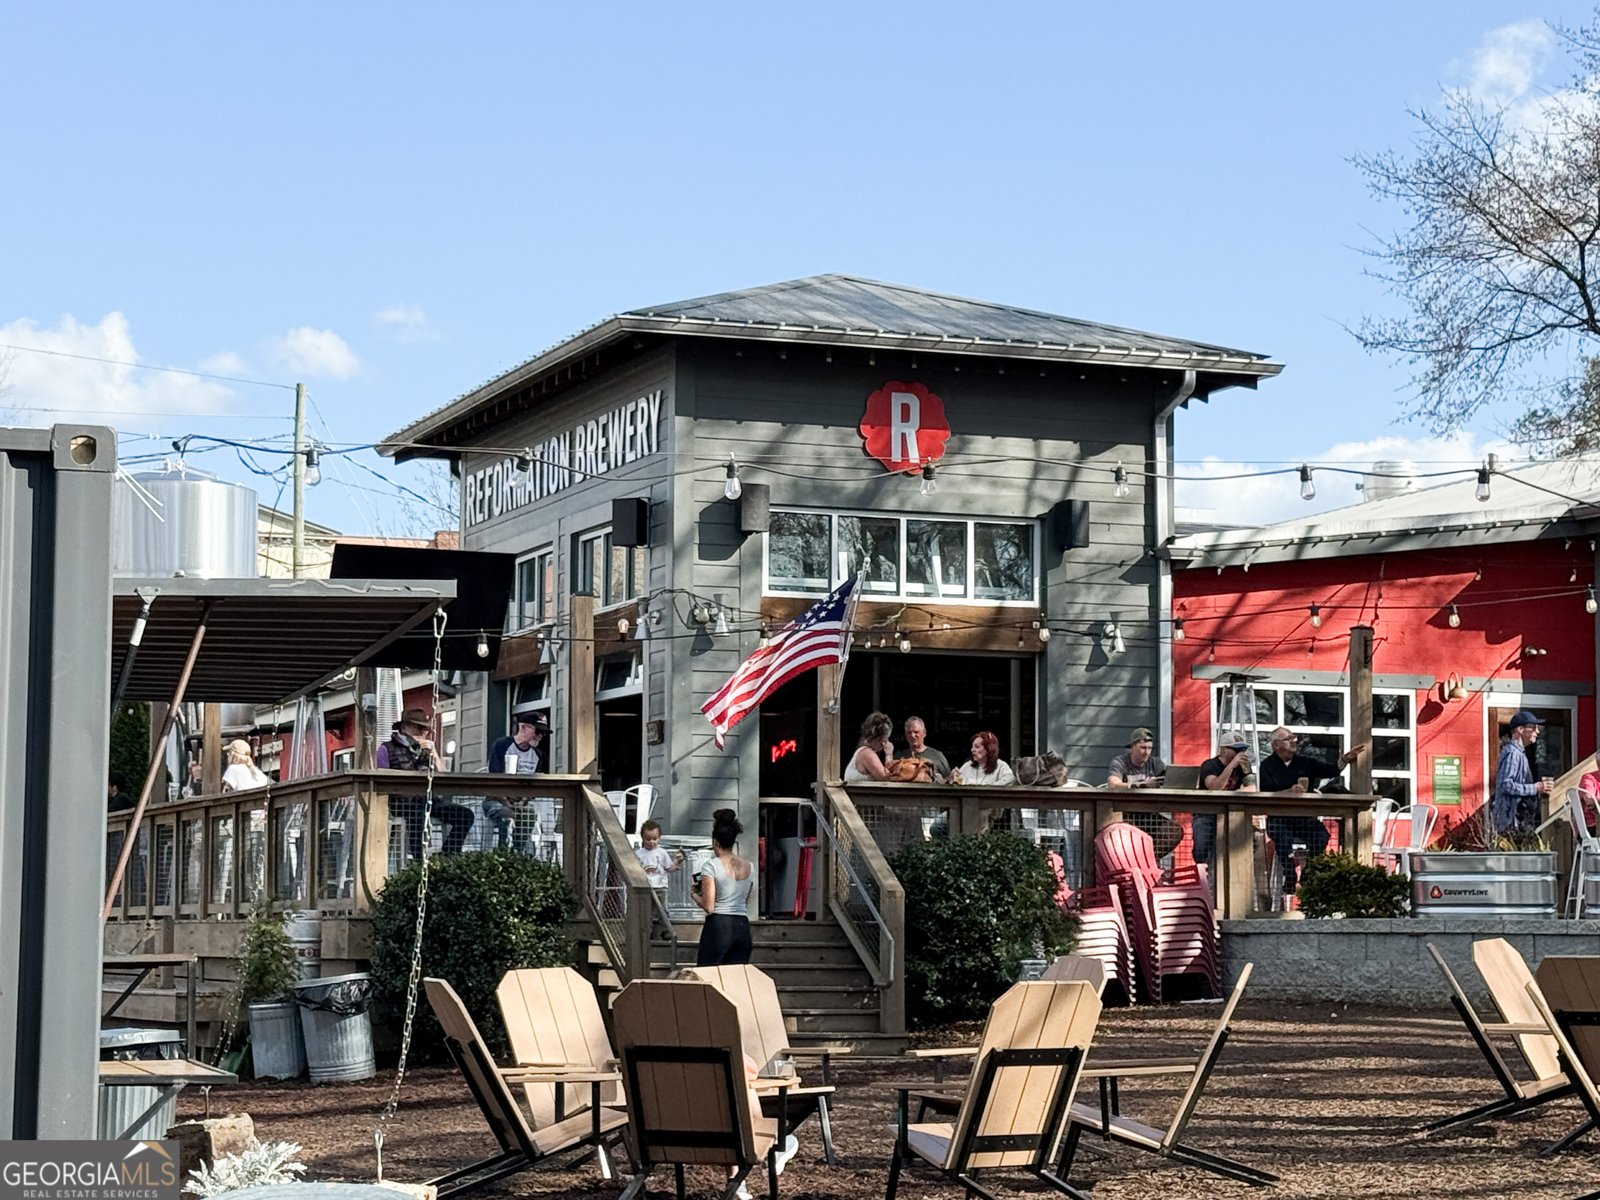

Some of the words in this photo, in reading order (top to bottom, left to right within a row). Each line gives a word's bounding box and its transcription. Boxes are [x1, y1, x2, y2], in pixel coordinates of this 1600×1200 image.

[465, 430, 572, 527] REFORMATION
[574, 390, 663, 484] BREWERY
[891, 391, 920, 464] R
